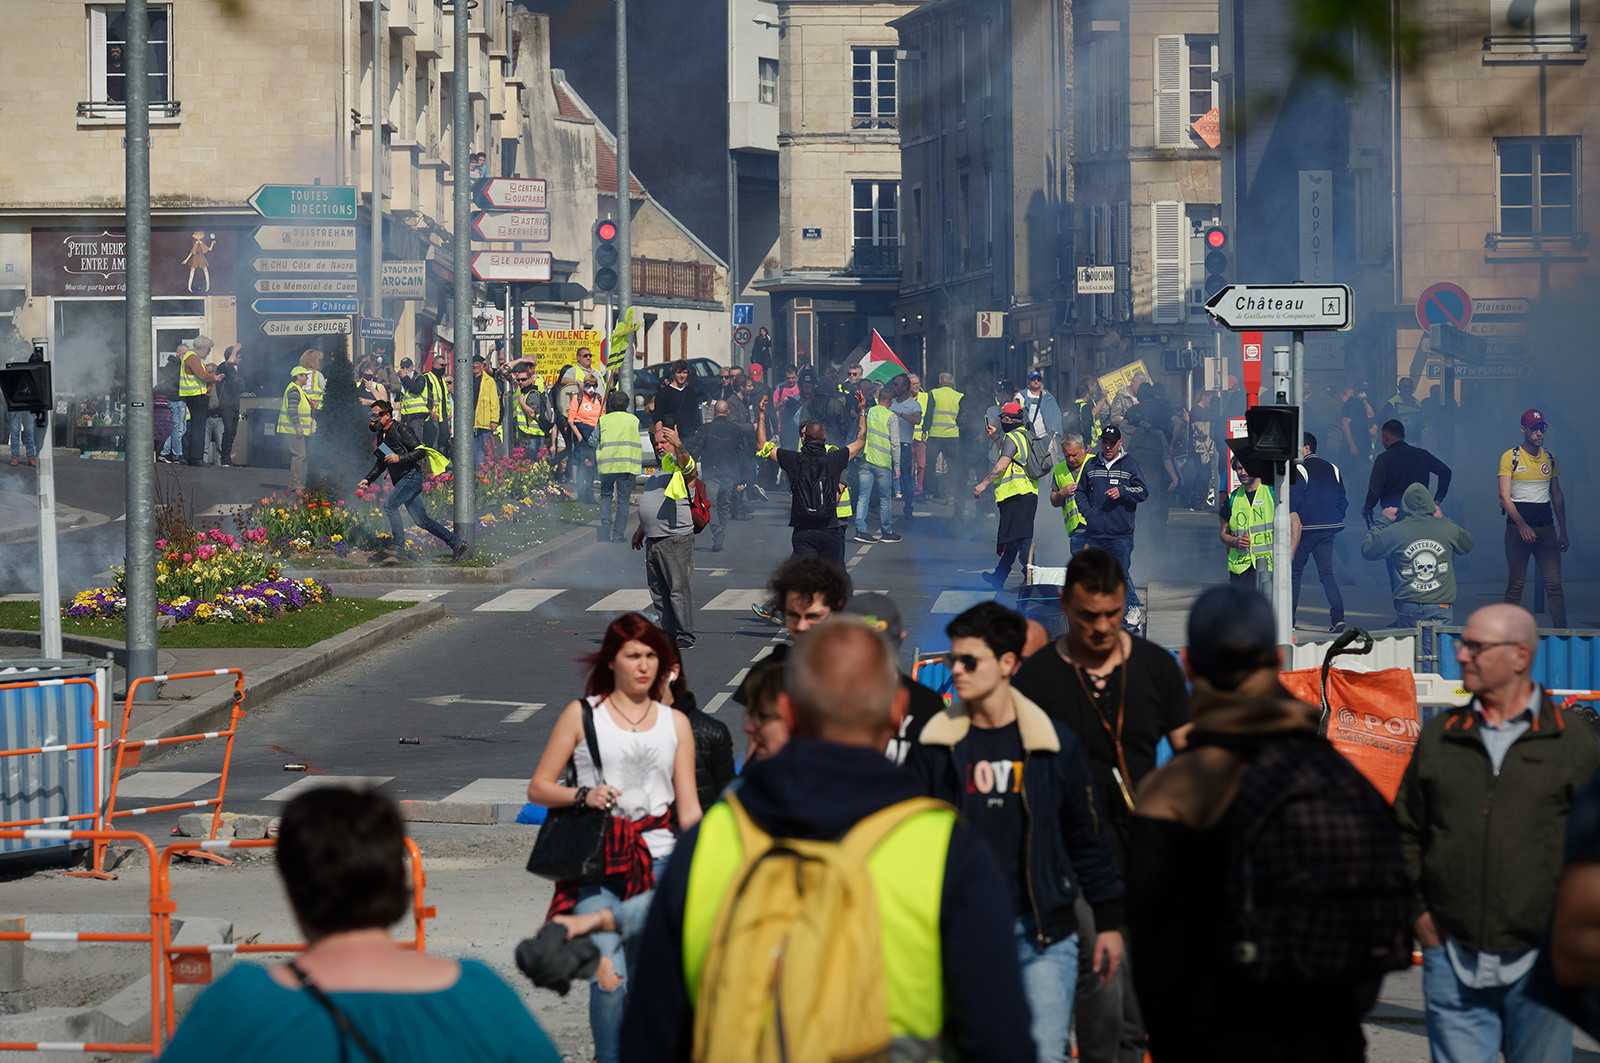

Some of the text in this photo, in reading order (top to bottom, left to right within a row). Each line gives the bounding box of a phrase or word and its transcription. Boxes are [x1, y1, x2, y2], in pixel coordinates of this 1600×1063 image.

[518, 184, 544, 193] CENTRAL
[291, 190, 329, 201] TOUTES
[512, 195, 545, 203] QUATRANS
[290, 203, 353, 215] DIRECTIONS
[520, 217, 548, 226] ASTRID
[293, 229, 354, 238] OUISTREHAM
[507, 226, 548, 236] BERNIÈRES
[68, 241, 127, 258] PETITS MEUR
[80, 257, 127, 271] ENTRE AM
[271, 261, 288, 269] CHU
[292, 261, 312, 270] Côte
[316, 261, 327, 269] de
[330, 261, 354, 269] Nacre
[501, 257, 549, 266] LE DAUPHIN
[382, 266, 424, 274] STAURANT
[1078, 270, 1085, 281] LE
[272, 282, 356, 290] Le Mémorial de Caen
[382, 276, 423, 287] AROCAIN
[88, 284, 104, 292] party
[322, 302, 356, 311] Château
[1235, 296, 1305, 310] Château
[1476, 303, 1522, 311] Plaisance
[1283, 312, 1317, 320] Conquérant
[270, 321, 348, 333] Salle du SÉPULCRE
[532, 330, 544, 339] LA
[592, 330, 598, 340] ?
[737, 331, 749, 341] 30
[1406, 541, 1442, 556] AMSTERDAM
